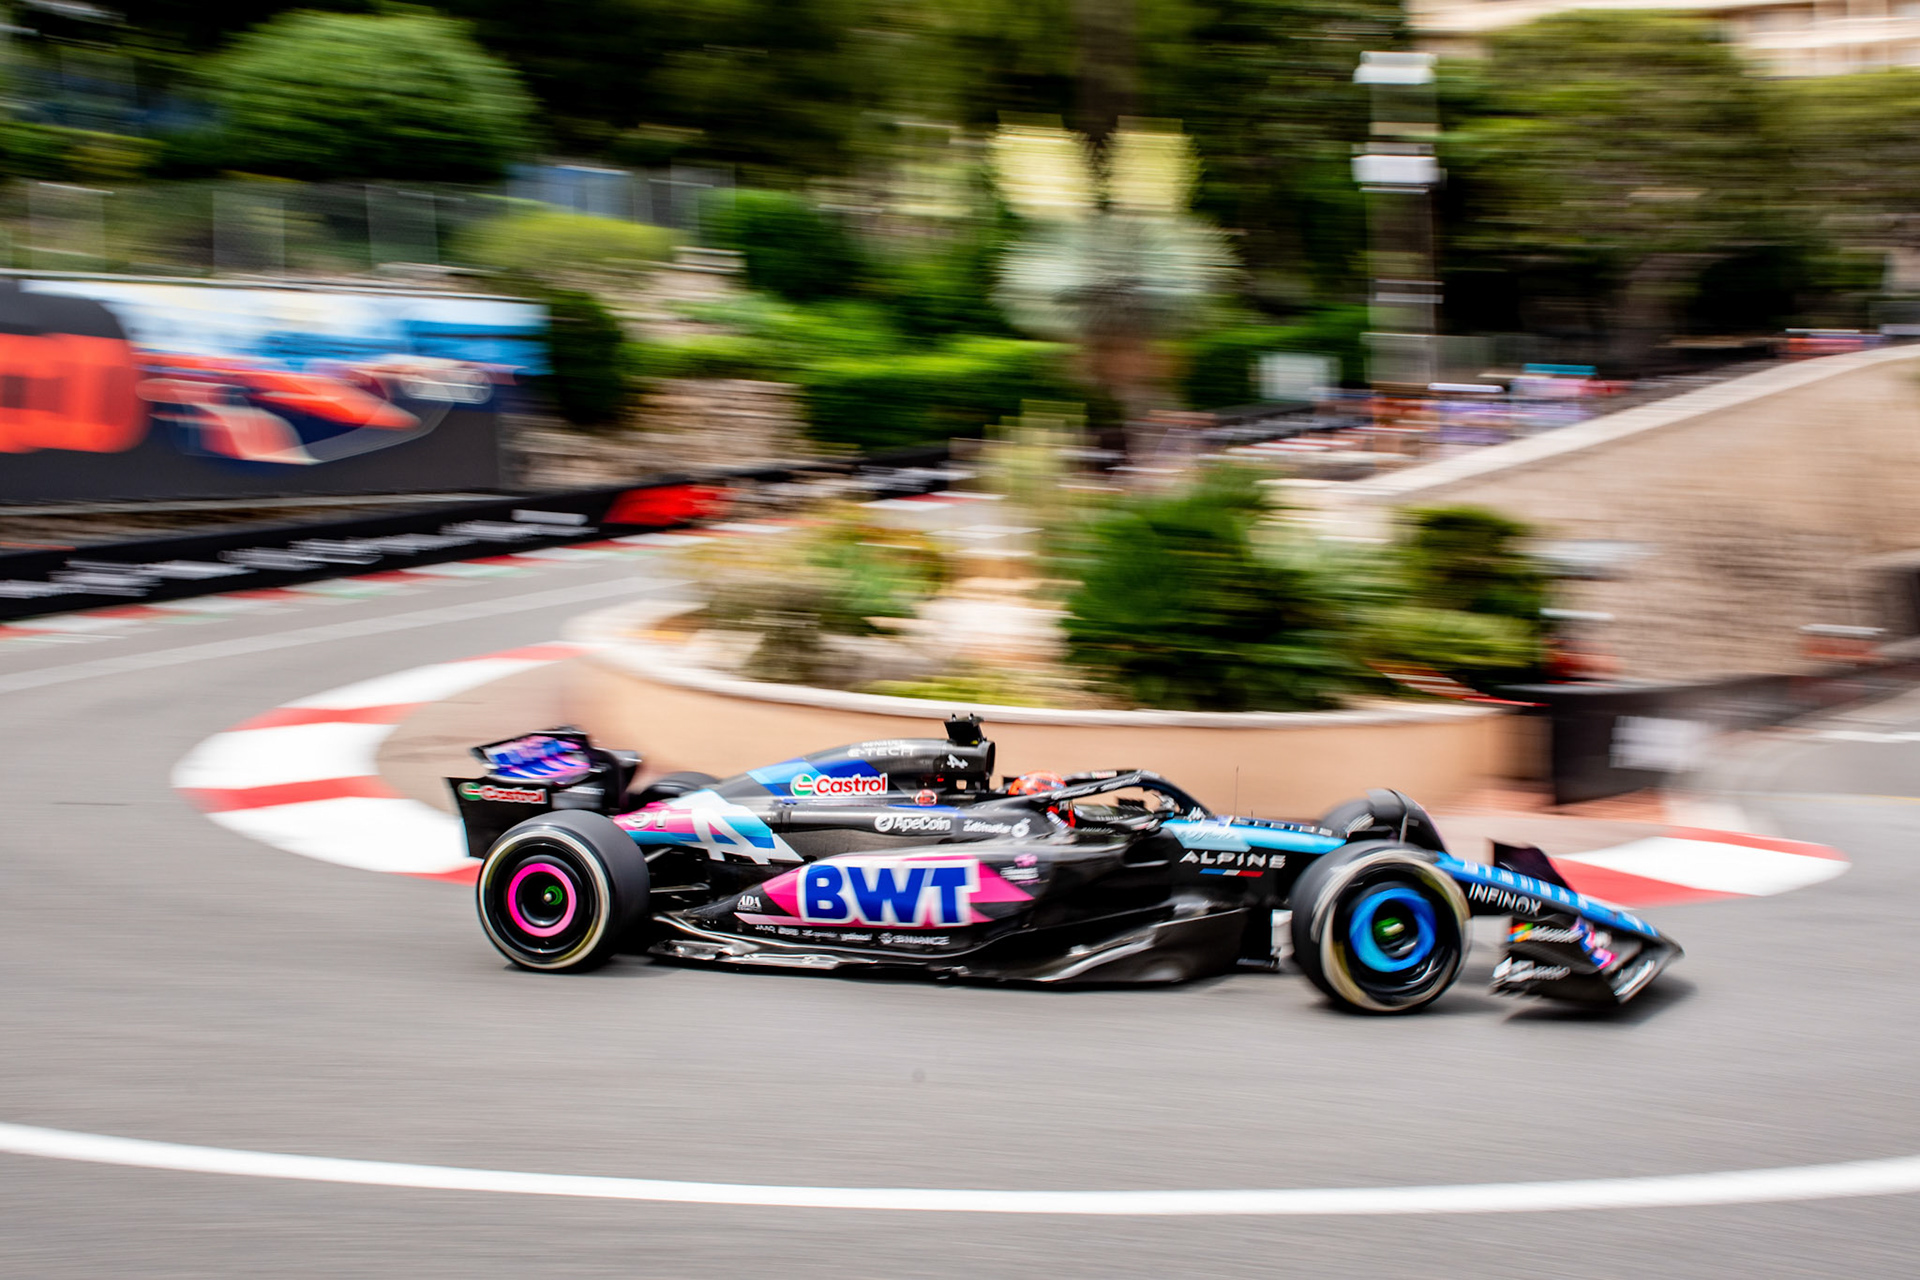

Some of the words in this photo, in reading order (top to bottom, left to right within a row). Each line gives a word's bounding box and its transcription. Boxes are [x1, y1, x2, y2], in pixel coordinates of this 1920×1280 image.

[815, 775, 888, 795] Castrol
[894, 815, 950, 832] ApeCoin
[1178, 849, 1286, 869] ALPINE
[737, 895, 762, 908] ADA
[802, 863, 968, 924] BWT
[1468, 882, 1541, 917] INFINOX
